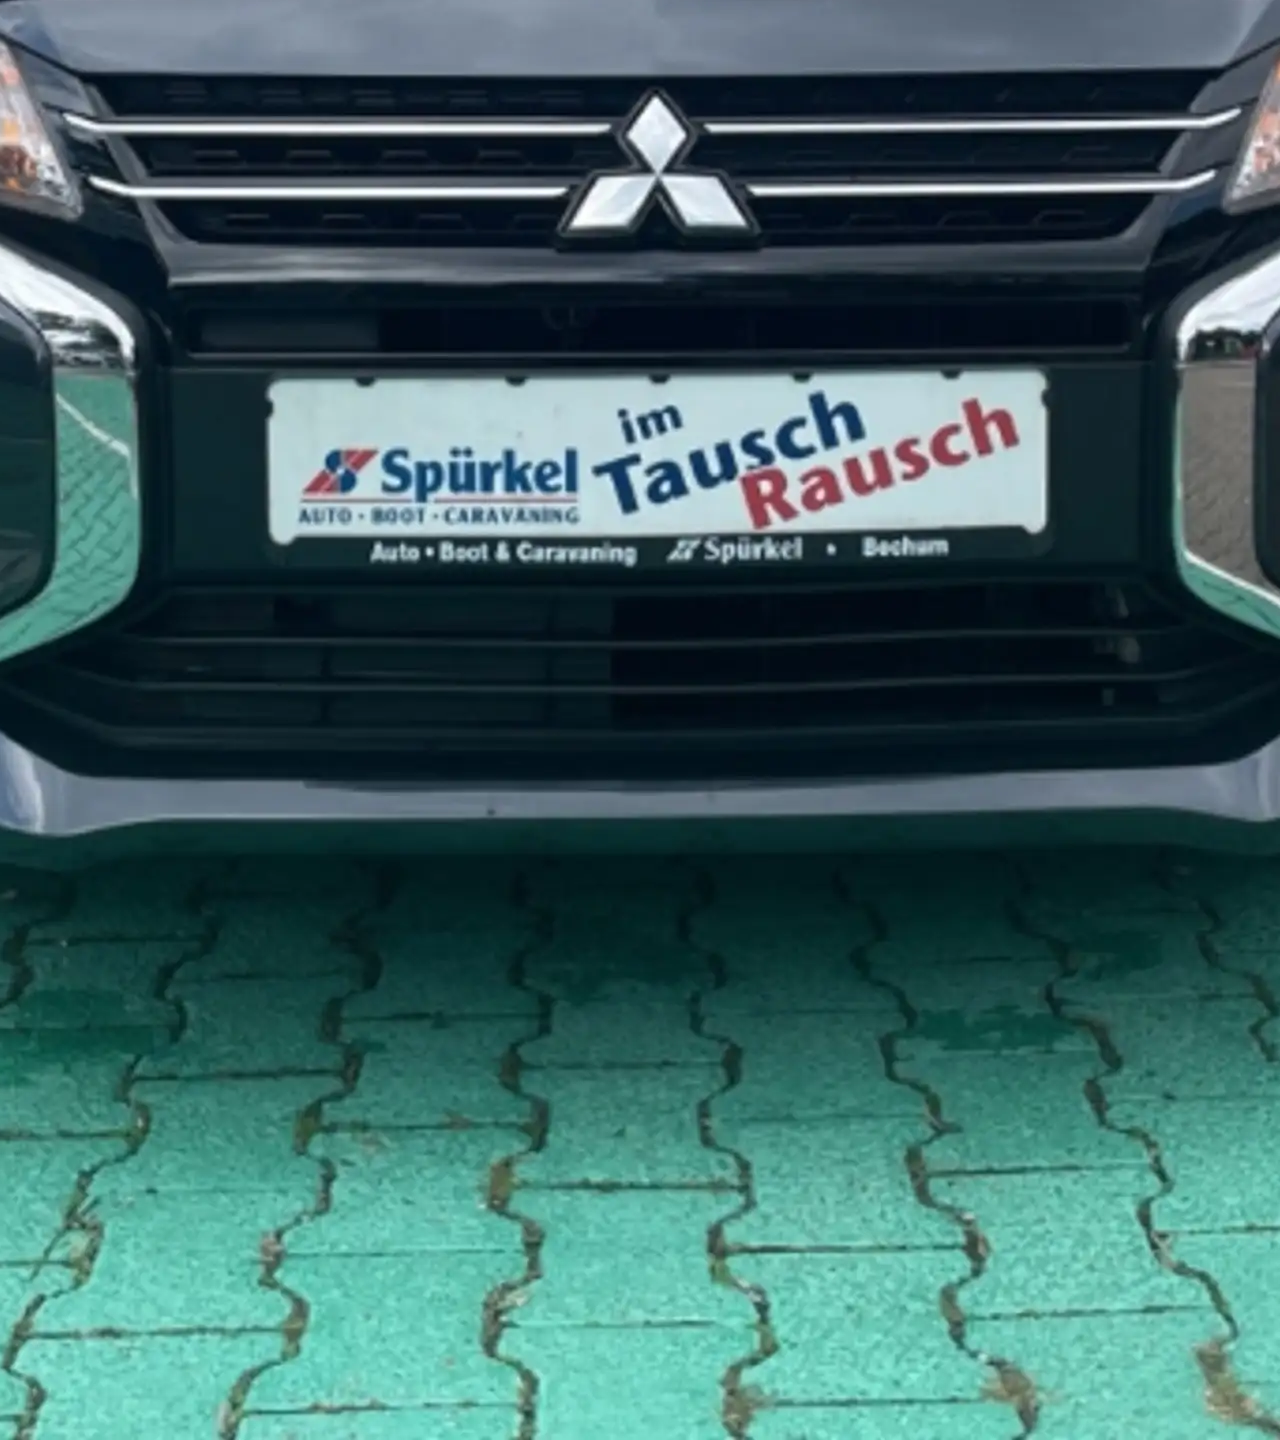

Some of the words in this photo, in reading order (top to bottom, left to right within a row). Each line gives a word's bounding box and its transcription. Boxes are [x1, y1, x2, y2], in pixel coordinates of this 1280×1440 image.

[618, 403, 683, 445] im
[380, 447, 578, 503] Spürkel
[592, 390, 866, 517] Tausch
[739, 397, 1020, 530] Rausch
[299, 506, 352, 525] AUTO
[370, 506, 425, 525] BOOT
[443, 505, 580, 525] CARAVANING
[370, 540, 421, 562] Auto
[439, 540, 489, 562] Boot
[494, 540, 512, 561] &
[516, 539, 638, 568] Caravaning
[704, 535, 804, 564] Spürkel
[862, 535, 950, 558] Bochum
